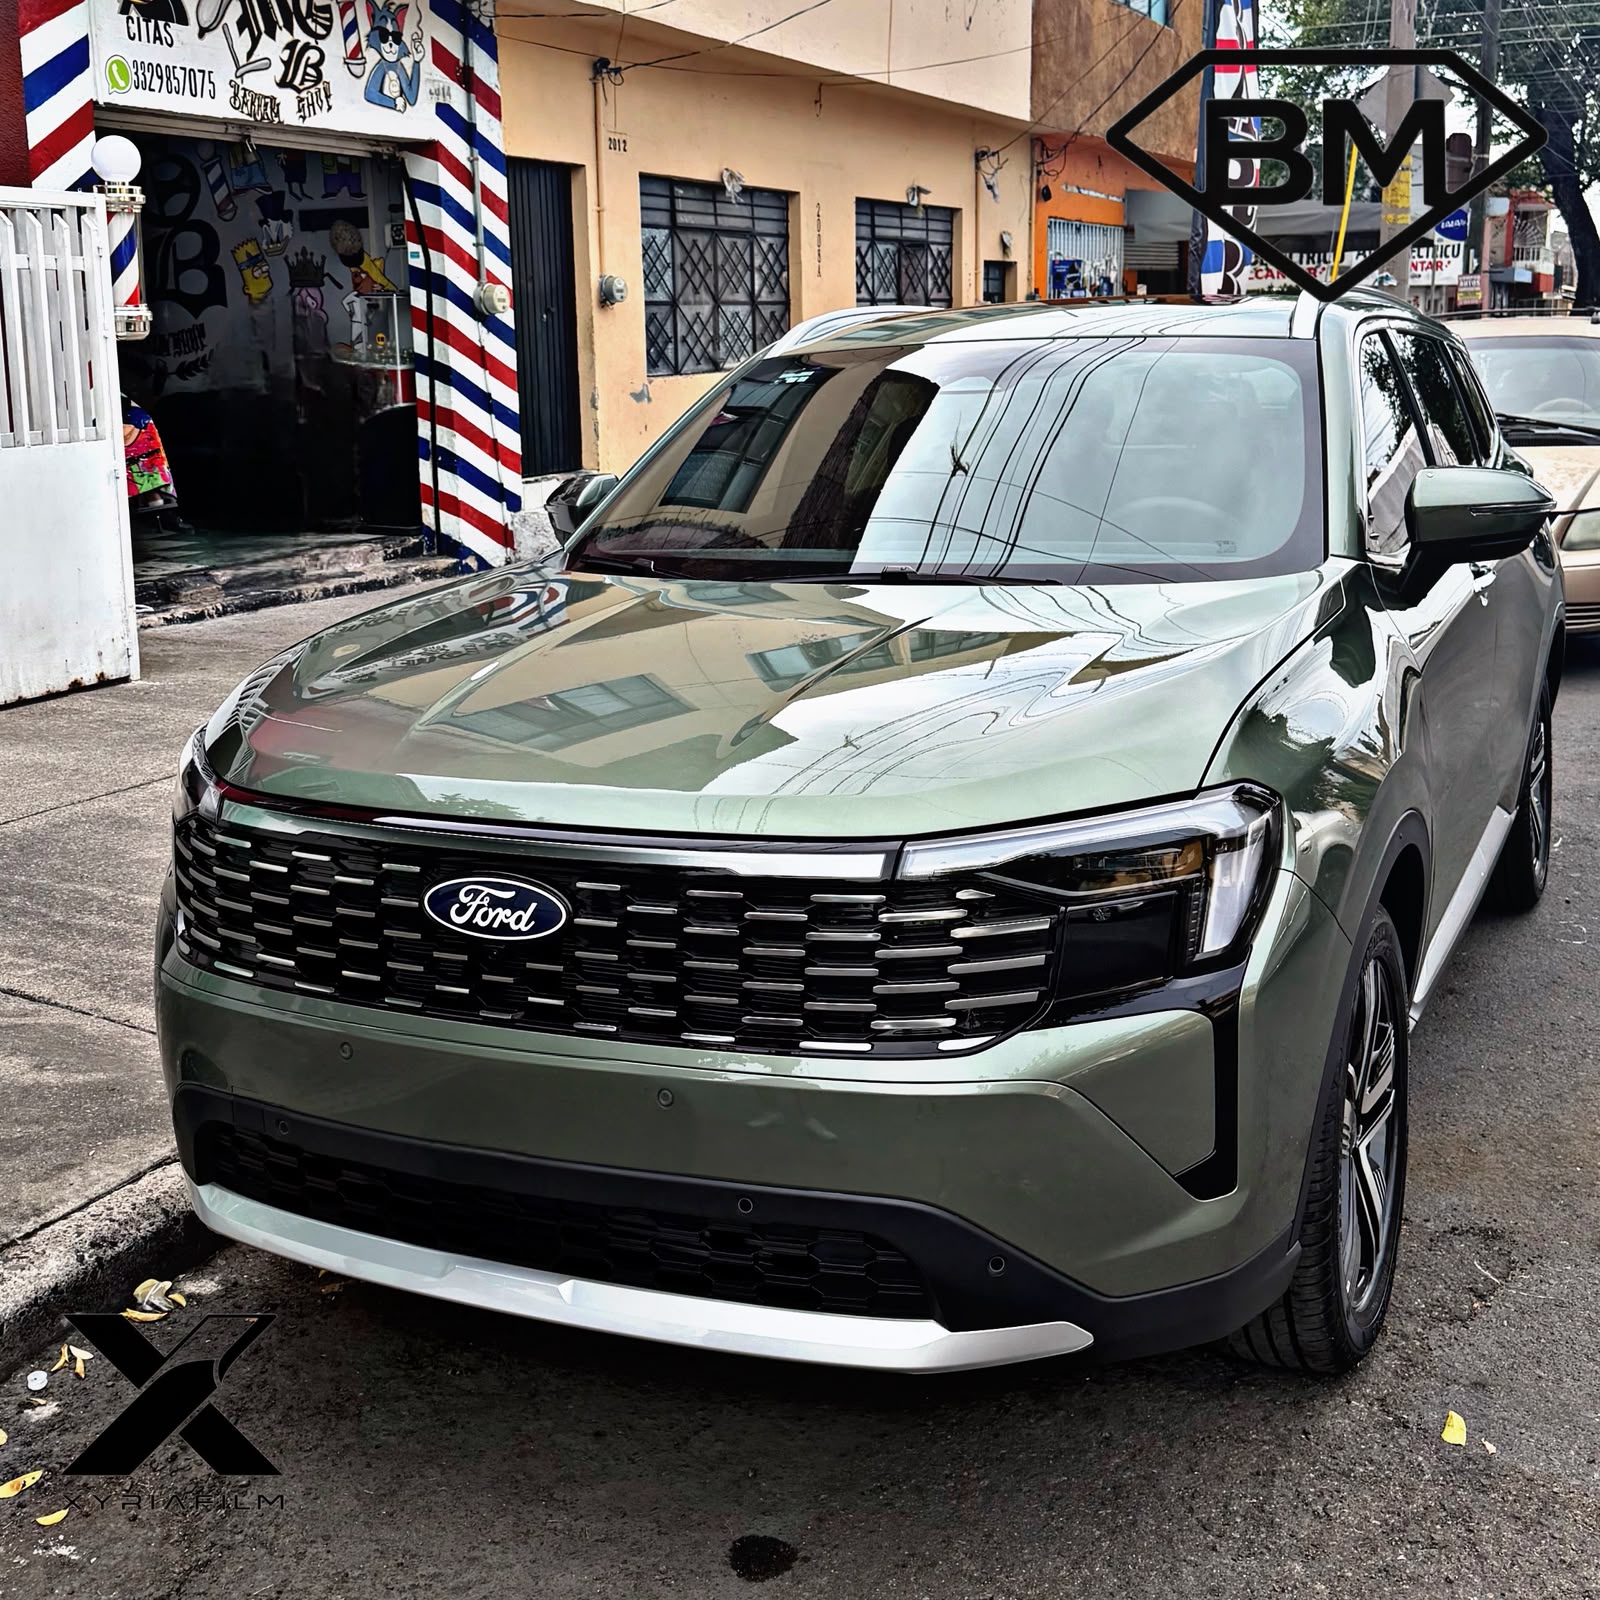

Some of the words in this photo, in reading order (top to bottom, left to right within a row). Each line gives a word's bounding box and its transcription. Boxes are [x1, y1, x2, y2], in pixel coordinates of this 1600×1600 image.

[125, 15, 174, 48] CITAS
[132, 59, 216, 100] 3329857075
[608, 136, 627, 153] 2012
[450, 884, 538, 932] Ford
